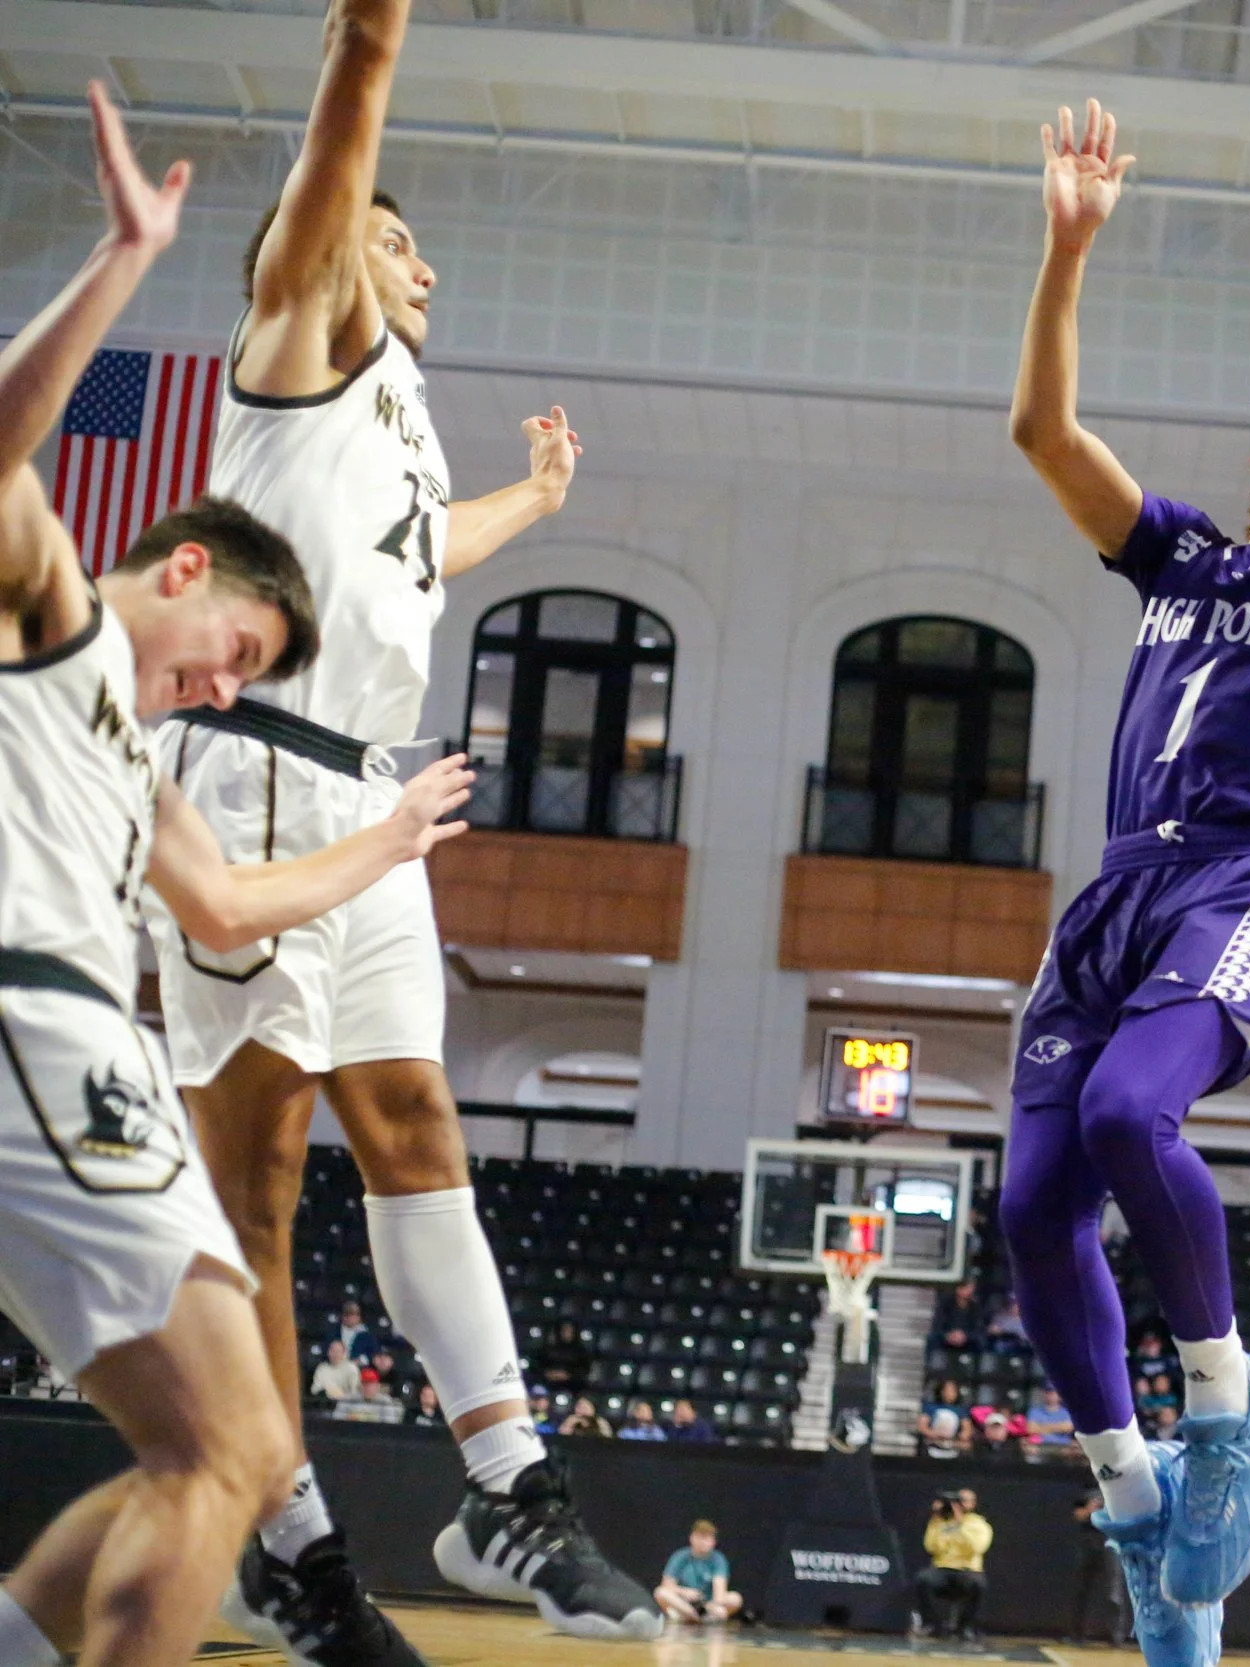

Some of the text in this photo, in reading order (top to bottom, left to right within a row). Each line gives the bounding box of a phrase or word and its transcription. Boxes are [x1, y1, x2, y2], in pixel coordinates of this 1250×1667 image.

[1135, 596, 1206, 646] HGH
[1154, 657, 1219, 763] 1
[843, 1039, 909, 1071] 13:43
[790, 1549, 890, 1575] WOFFORD
